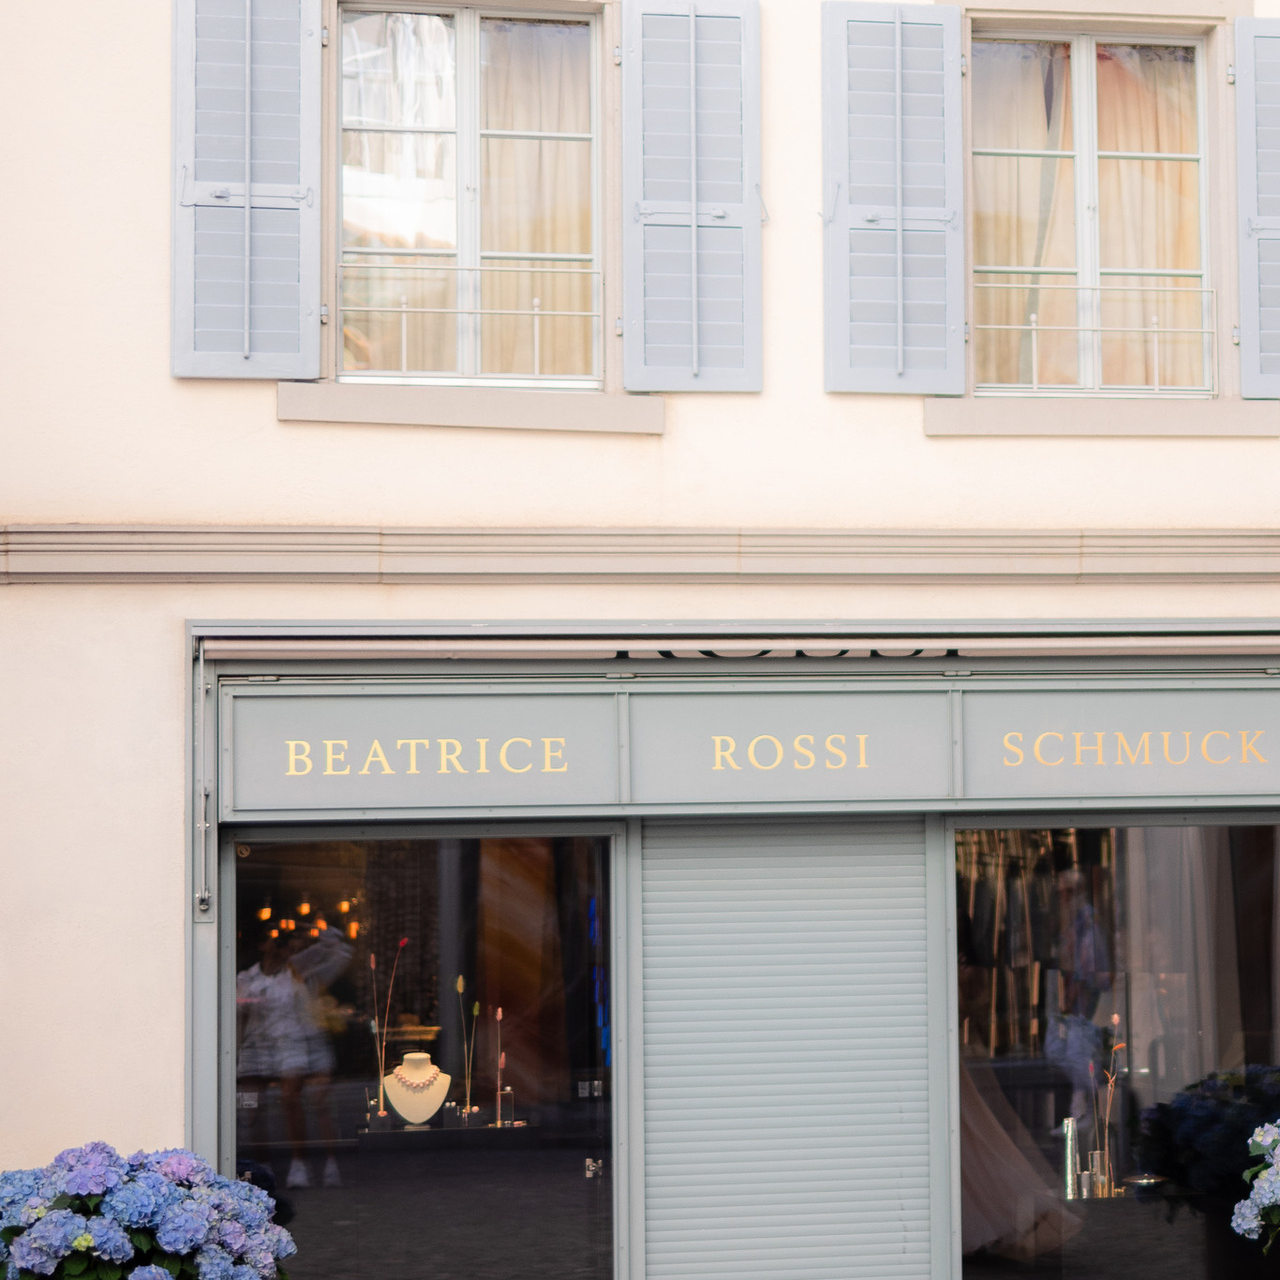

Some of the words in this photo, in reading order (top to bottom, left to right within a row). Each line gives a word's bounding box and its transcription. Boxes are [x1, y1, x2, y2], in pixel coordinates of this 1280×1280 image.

[284, 736, 570, 776] BEATRICE
[711, 733, 870, 771] ROSSI
[1002, 729, 1270, 767] SCHMUCK
